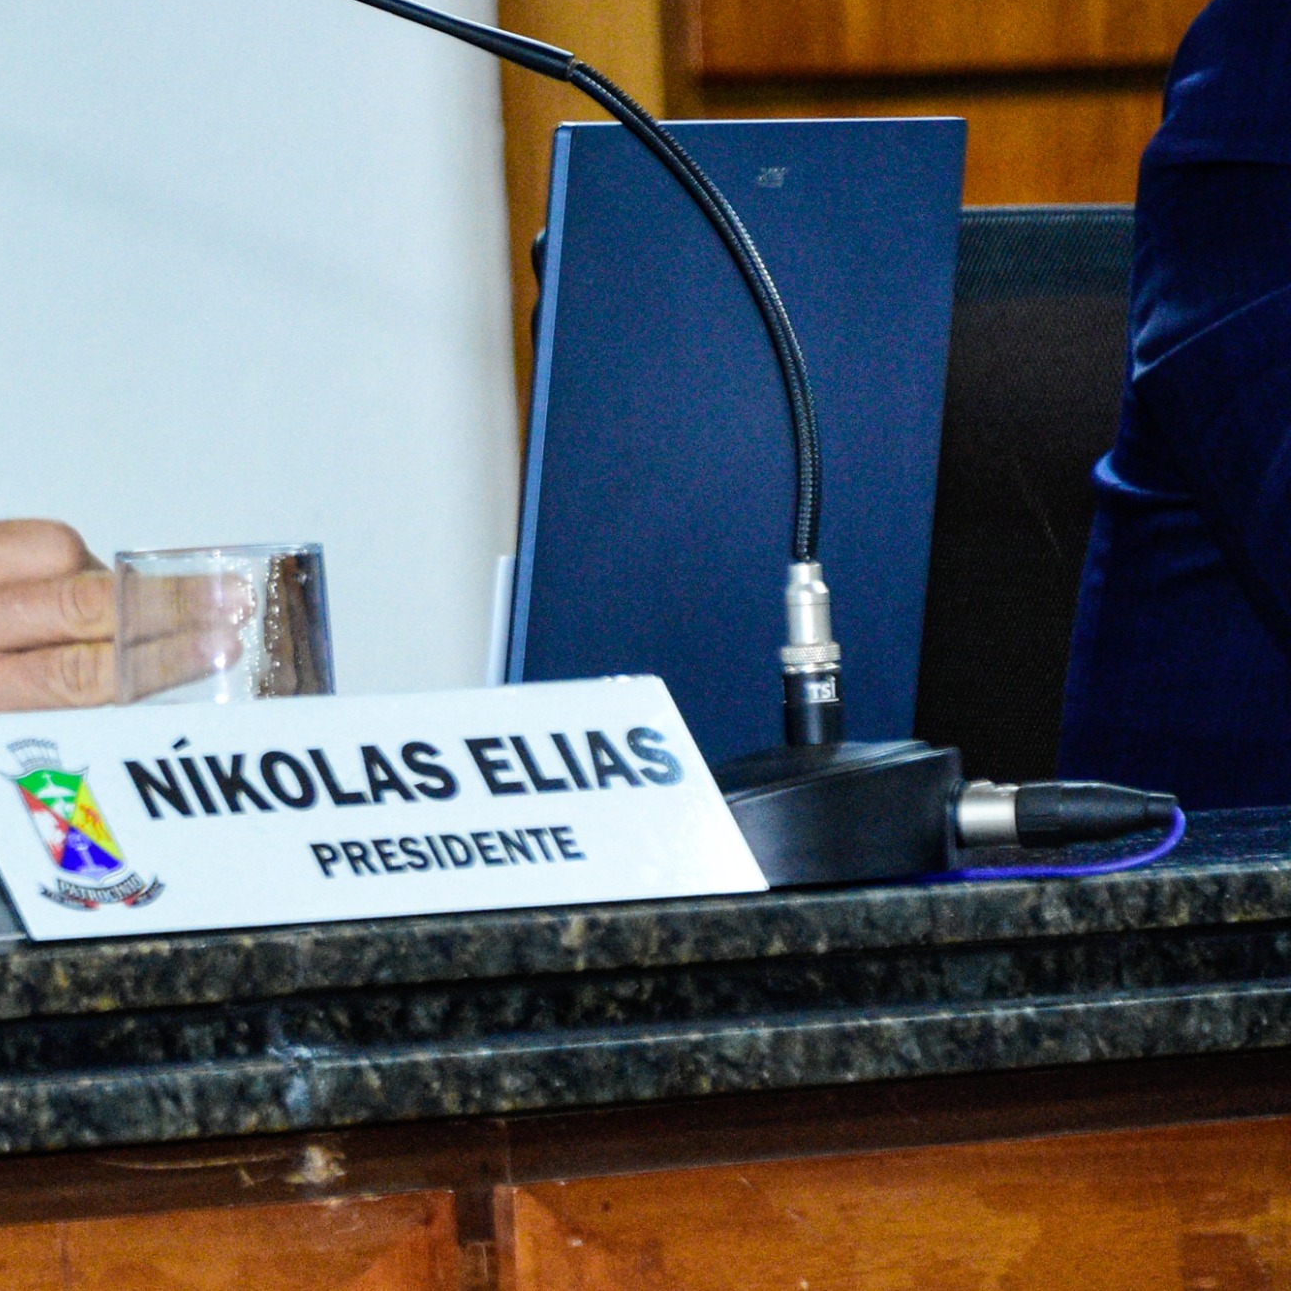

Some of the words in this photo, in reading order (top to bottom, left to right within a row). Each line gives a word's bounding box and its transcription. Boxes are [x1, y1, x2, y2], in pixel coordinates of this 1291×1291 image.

[122, 736, 459, 820] NÍKOLAS
[463, 726, 684, 797] ELIAS
[309, 825, 587, 878] PRESIDENTE
